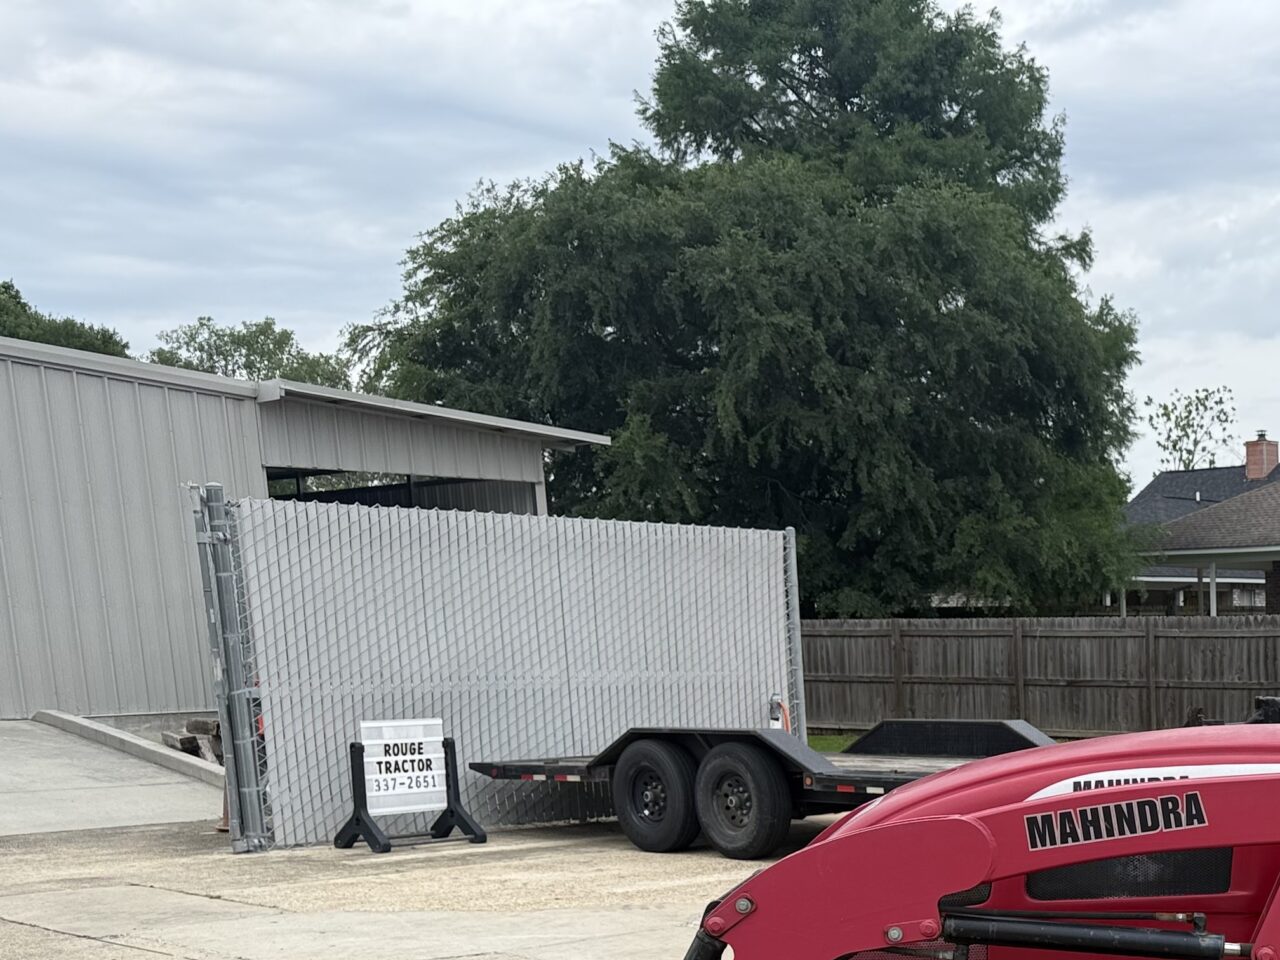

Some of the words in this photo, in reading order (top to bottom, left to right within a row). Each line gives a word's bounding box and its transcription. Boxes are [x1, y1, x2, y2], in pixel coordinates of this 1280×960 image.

[384, 742, 424, 757] ROUGE
[376, 758, 433, 775] TRACTOR
[374, 774, 437, 792] 337-2651
[1025, 792, 1207, 850] MAHINDRA
